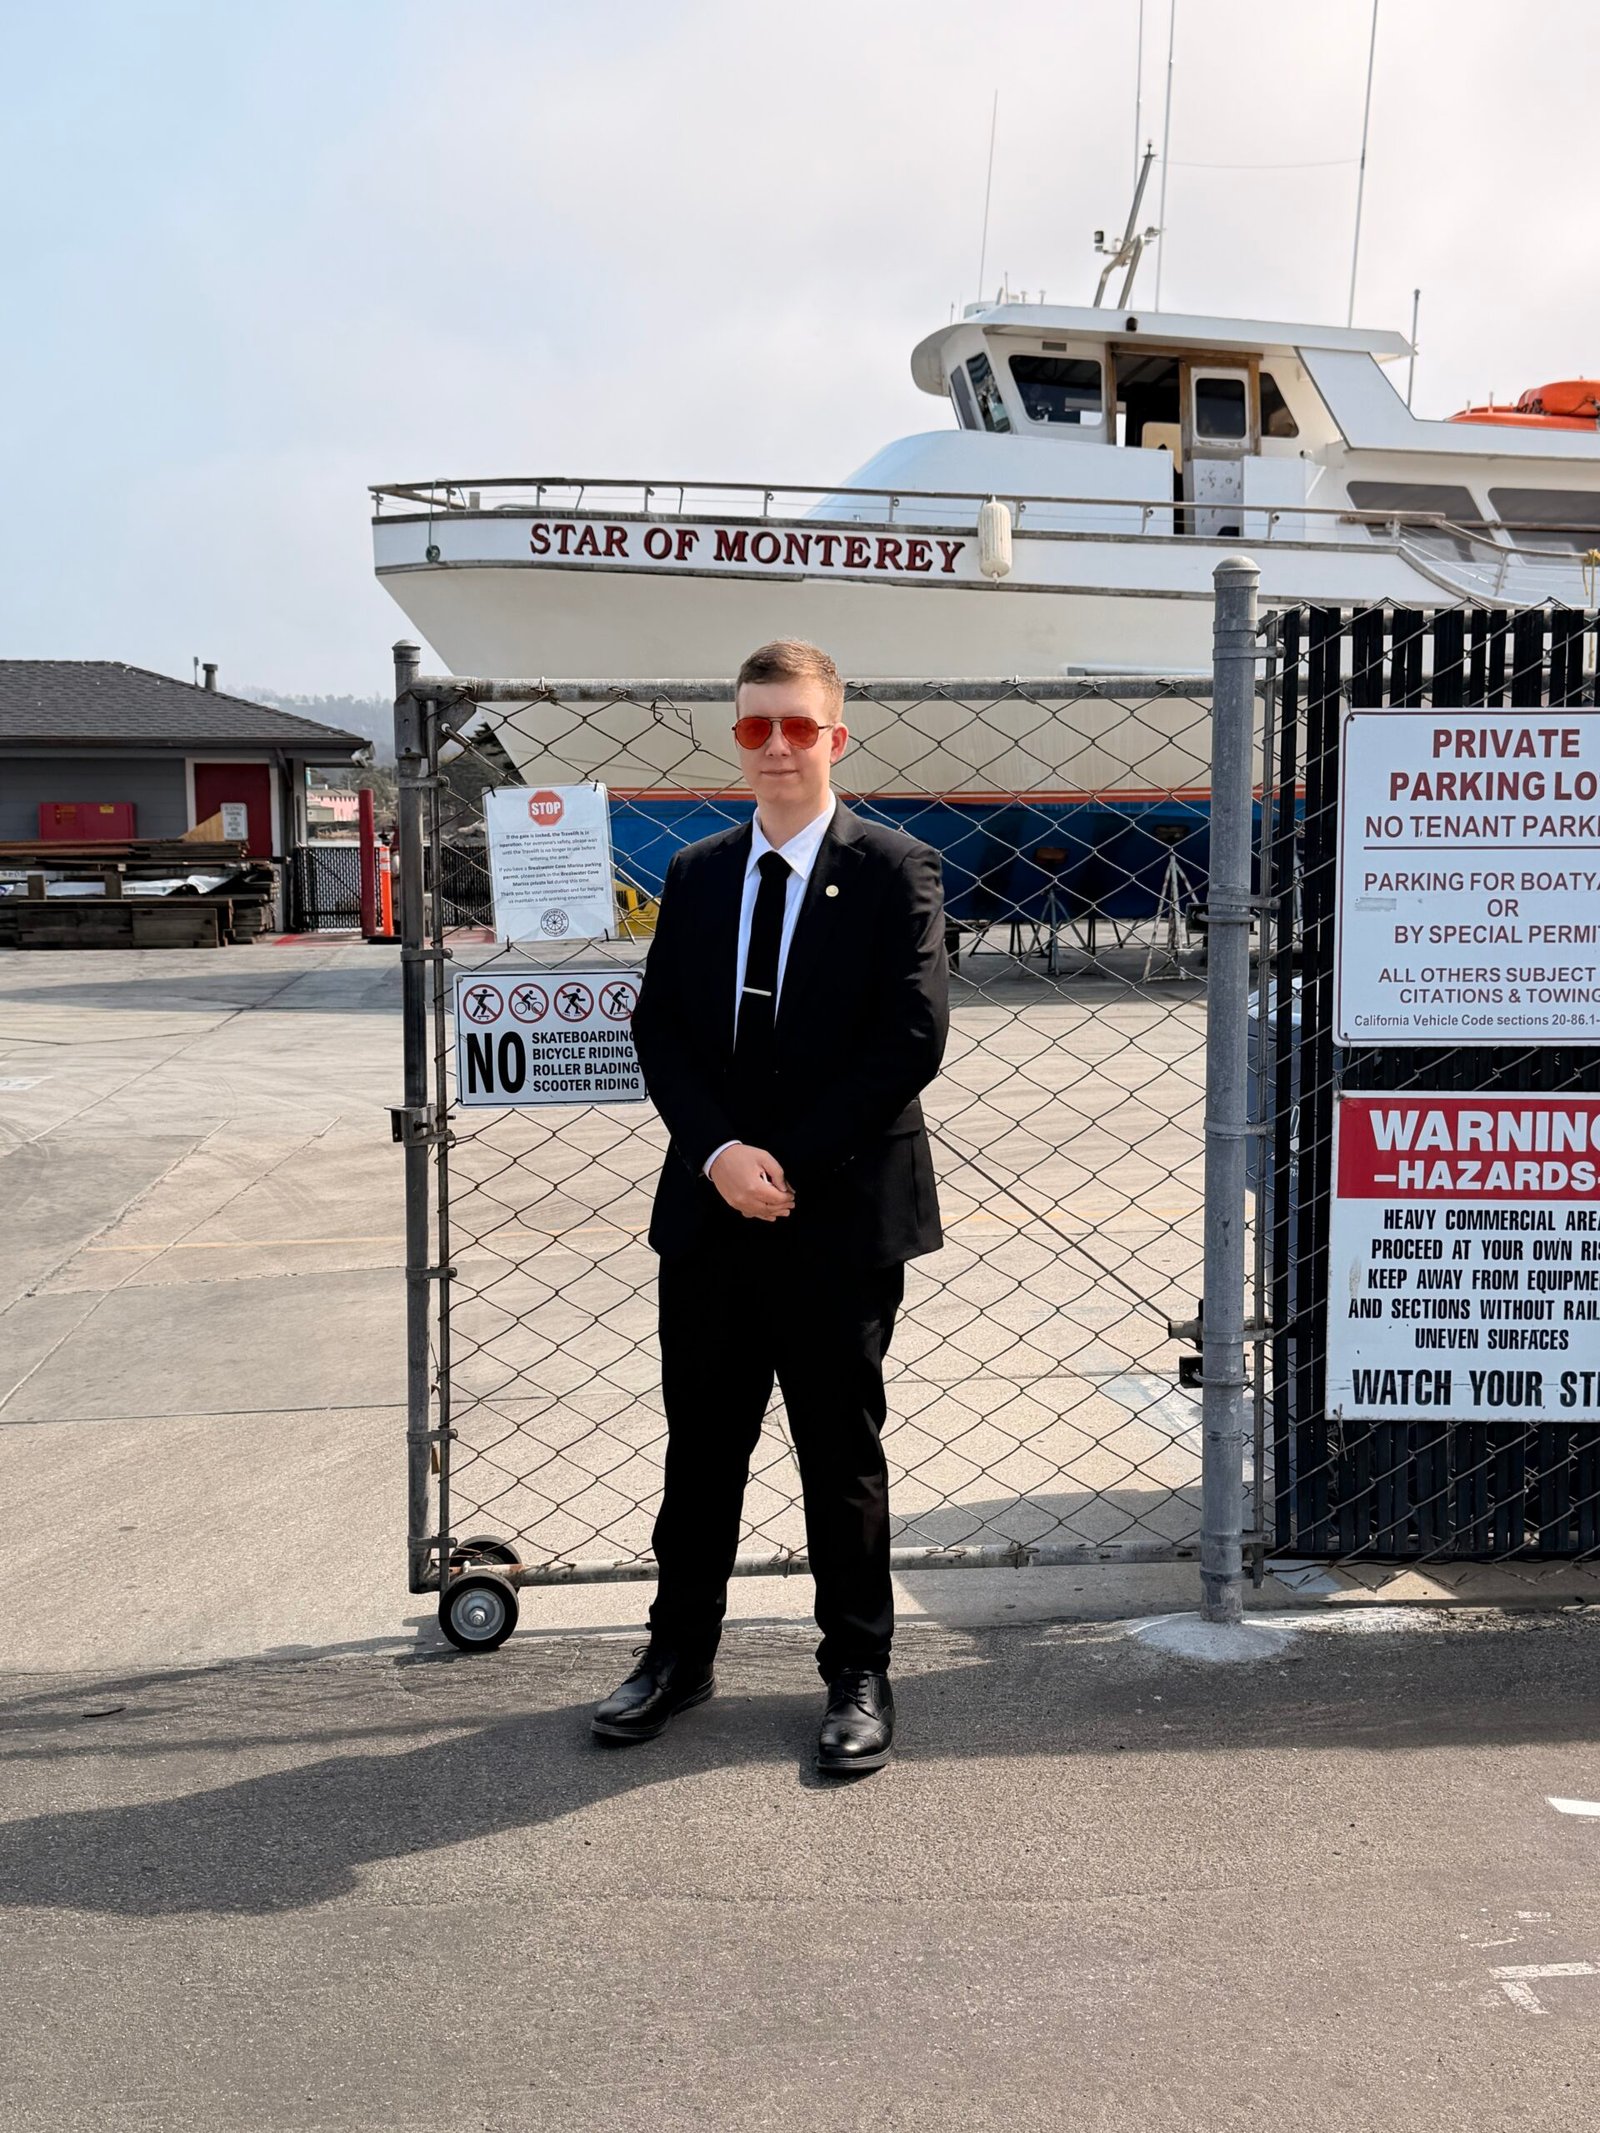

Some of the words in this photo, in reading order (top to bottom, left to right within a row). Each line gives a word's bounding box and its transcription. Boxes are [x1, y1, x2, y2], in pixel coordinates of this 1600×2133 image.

[530, 522, 629, 557] STAR
[644, 527, 699, 560] OF
[714, 530, 965, 574] MONTEREY
[1432, 729, 1580, 758] PRIVATE
[1390, 772, 1545, 801] PARKING
[1554, 771, 1600, 801] LO
[532, 802, 560, 816] STOP
[1365, 816, 1403, 838] NO
[1410, 816, 1516, 837] TENANT
[1364, 873, 1464, 892] PARKING
[1470, 872, 1515, 890] FOR
[1521, 872, 1600, 890] BOATY
[1487, 899, 1519, 917] OR
[1394, 926, 1424, 944] BY
[1428, 926, 1522, 944] SPECIAL
[1528, 925, 1600, 944] PERMI
[1378, 968, 1415, 982] ALL
[1421, 968, 1500, 982] OTHERS
[1506, 968, 1596, 982] SUBJECT
[1400, 988, 1503, 1004] CITATIONS
[1508, 988, 1521, 1004] &
[1526, 988, 1600, 1004] TOWING
[1354, 1014, 1409, 1026] California
[1413, 1014, 1458, 1026] Vehicle
[1462, 1014, 1494, 1026] Code
[1497, 1014, 1549, 1026] sections
[467, 1031, 526, 1094] NO
[533, 1048, 586, 1060] BICYCLE
[589, 1046, 632, 1058] RIDING
[533, 1064, 580, 1076] ROLLER
[585, 1062, 640, 1074] BLADING
[534, 1079, 591, 1092] SCOOTER
[595, 1078, 639, 1090] RIDING
[1369, 1110, 1600, 1152] WARNIN
[1374, 1160, 1600, 1191] -HAZARDS
[1384, 1209, 1436, 1230] HEAVY
[1446, 1210, 1556, 1231] COMMERCIAL
[1566, 1210, 1600, 1231] ARE
[1372, 1239, 1442, 1260] PROCEED
[1452, 1240, 1472, 1260] AT
[1482, 1240, 1524, 1260] YOUR
[1533, 1240, 1572, 1260] OWN
[1368, 1269, 1407, 1289] KEEP
[1416, 1270, 1463, 1290] AWAY
[1472, 1270, 1518, 1290] FROM
[1528, 1270, 1600, 1294] EQUIPME
[1348, 1299, 1382, 1318] AND
[1391, 1299, 1470, 1320] SECTIONS
[1480, 1300, 1555, 1320] WITHOUT
[1415, 1328, 1478, 1349] UNEVEN
[1488, 1329, 1569, 1350] SURFACES
[1352, 1369, 1452, 1406] WATCH
[1469, 1370, 1542, 1406] YOUR
[1560, 1370, 1600, 1407] ST
